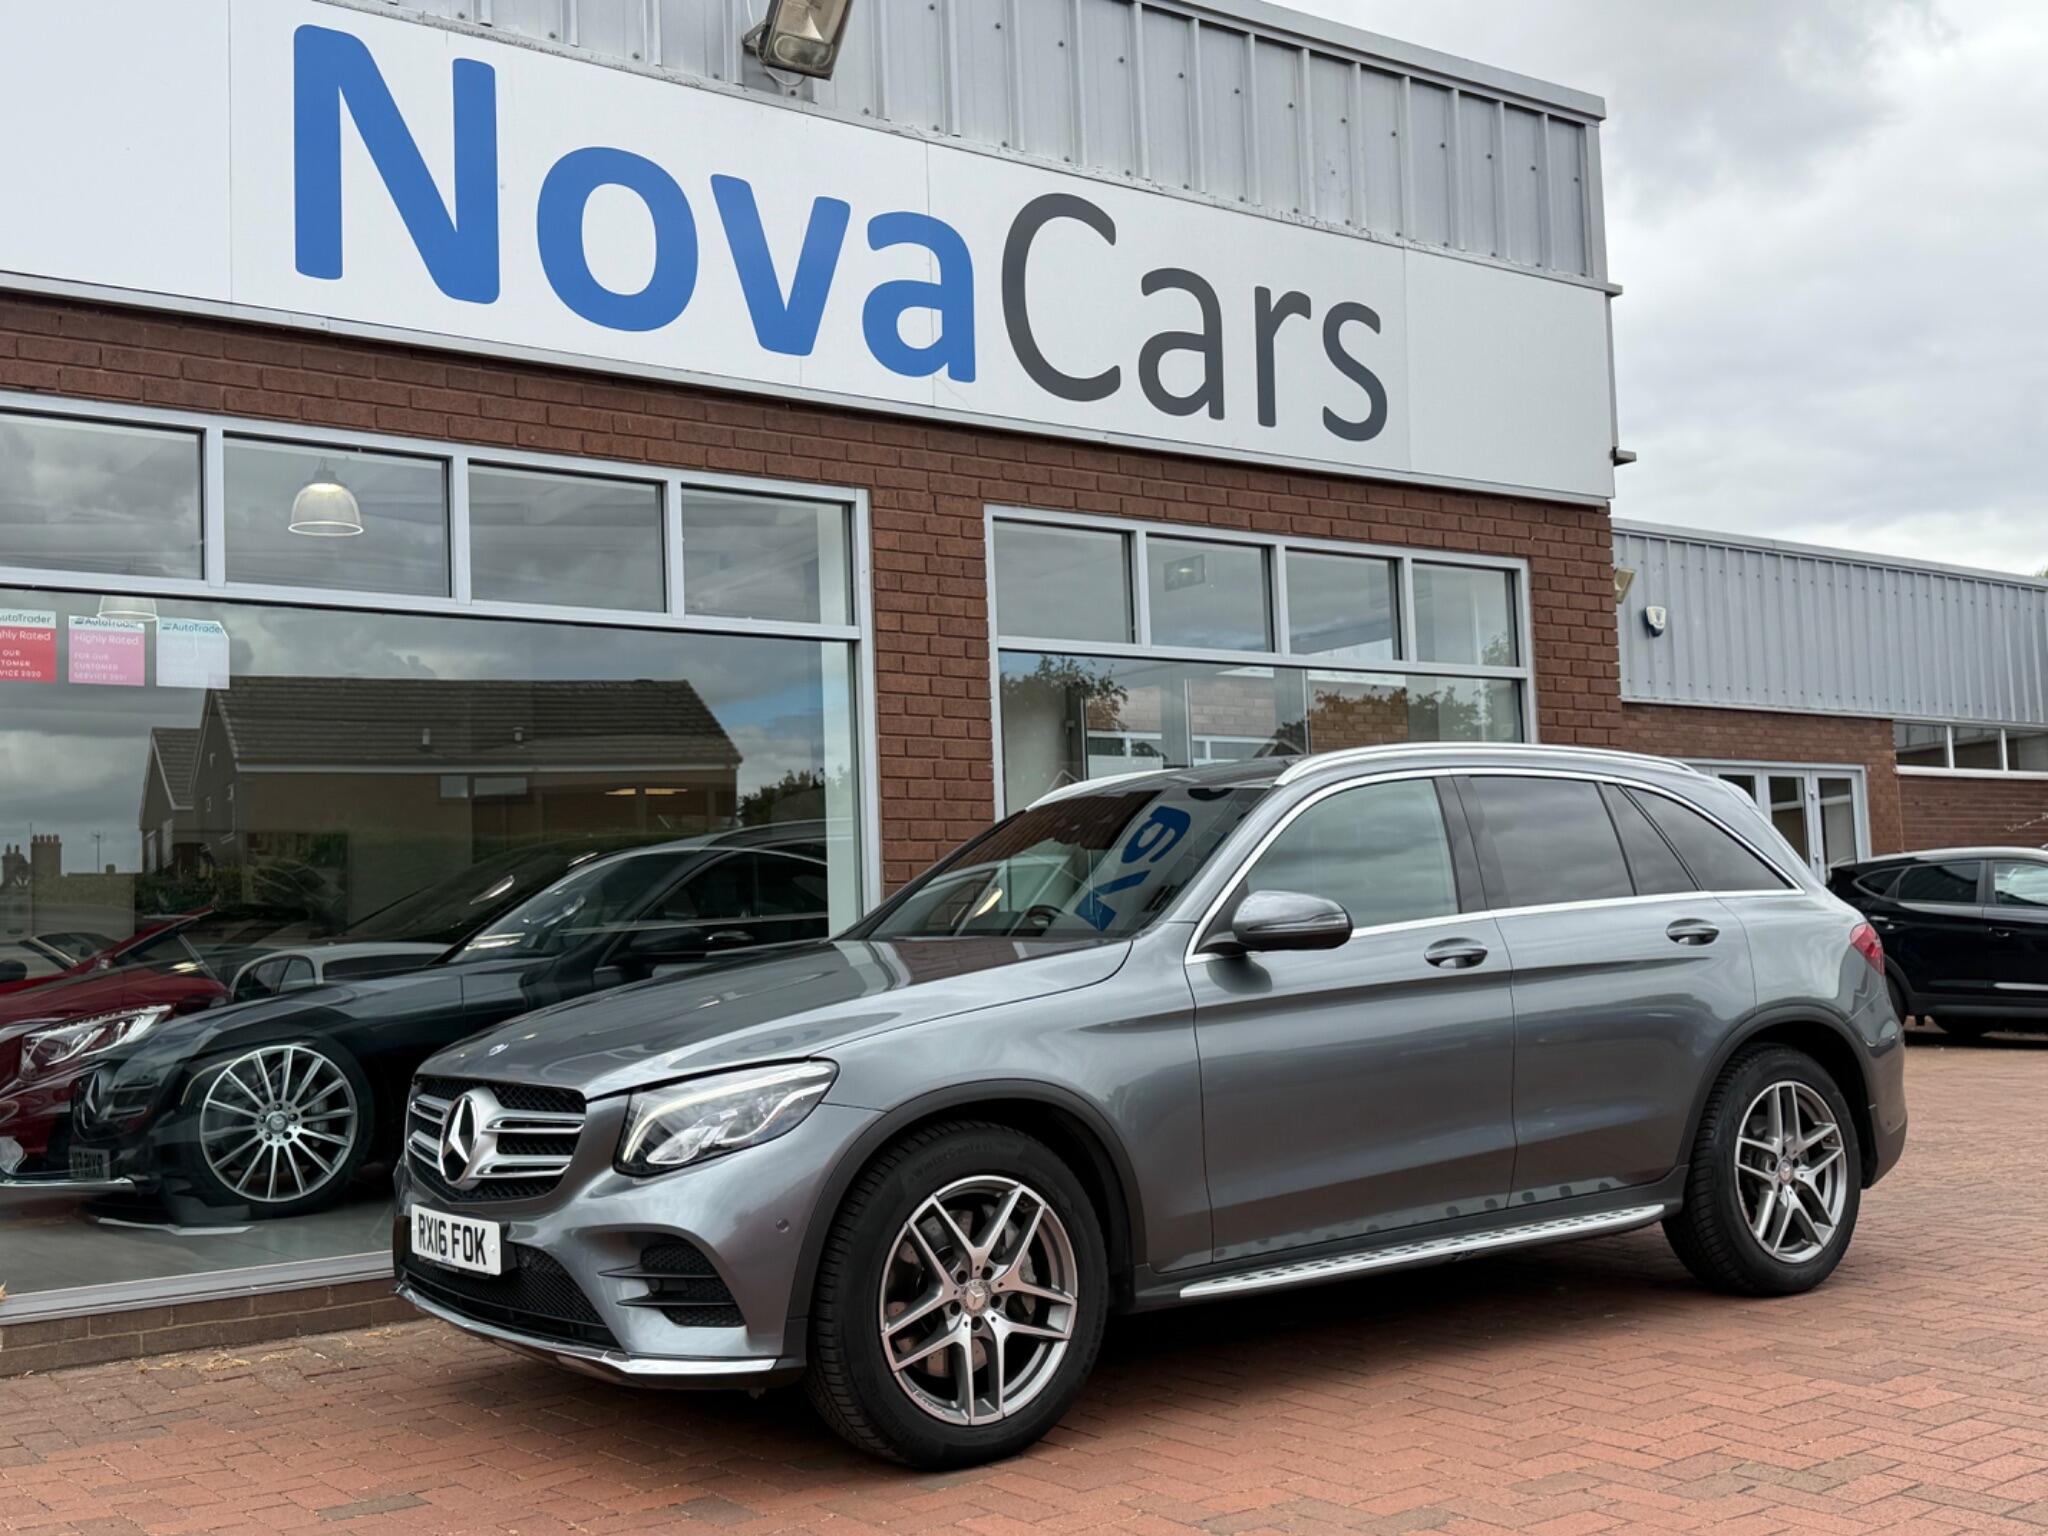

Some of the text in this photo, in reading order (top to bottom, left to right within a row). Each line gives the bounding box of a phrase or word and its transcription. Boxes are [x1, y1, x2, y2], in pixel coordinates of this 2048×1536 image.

[19, 631, 51, 640] Rated
[74, 633, 139, 645] Highly Rated
[418, 1213, 487, 1266] RX16 FOK
